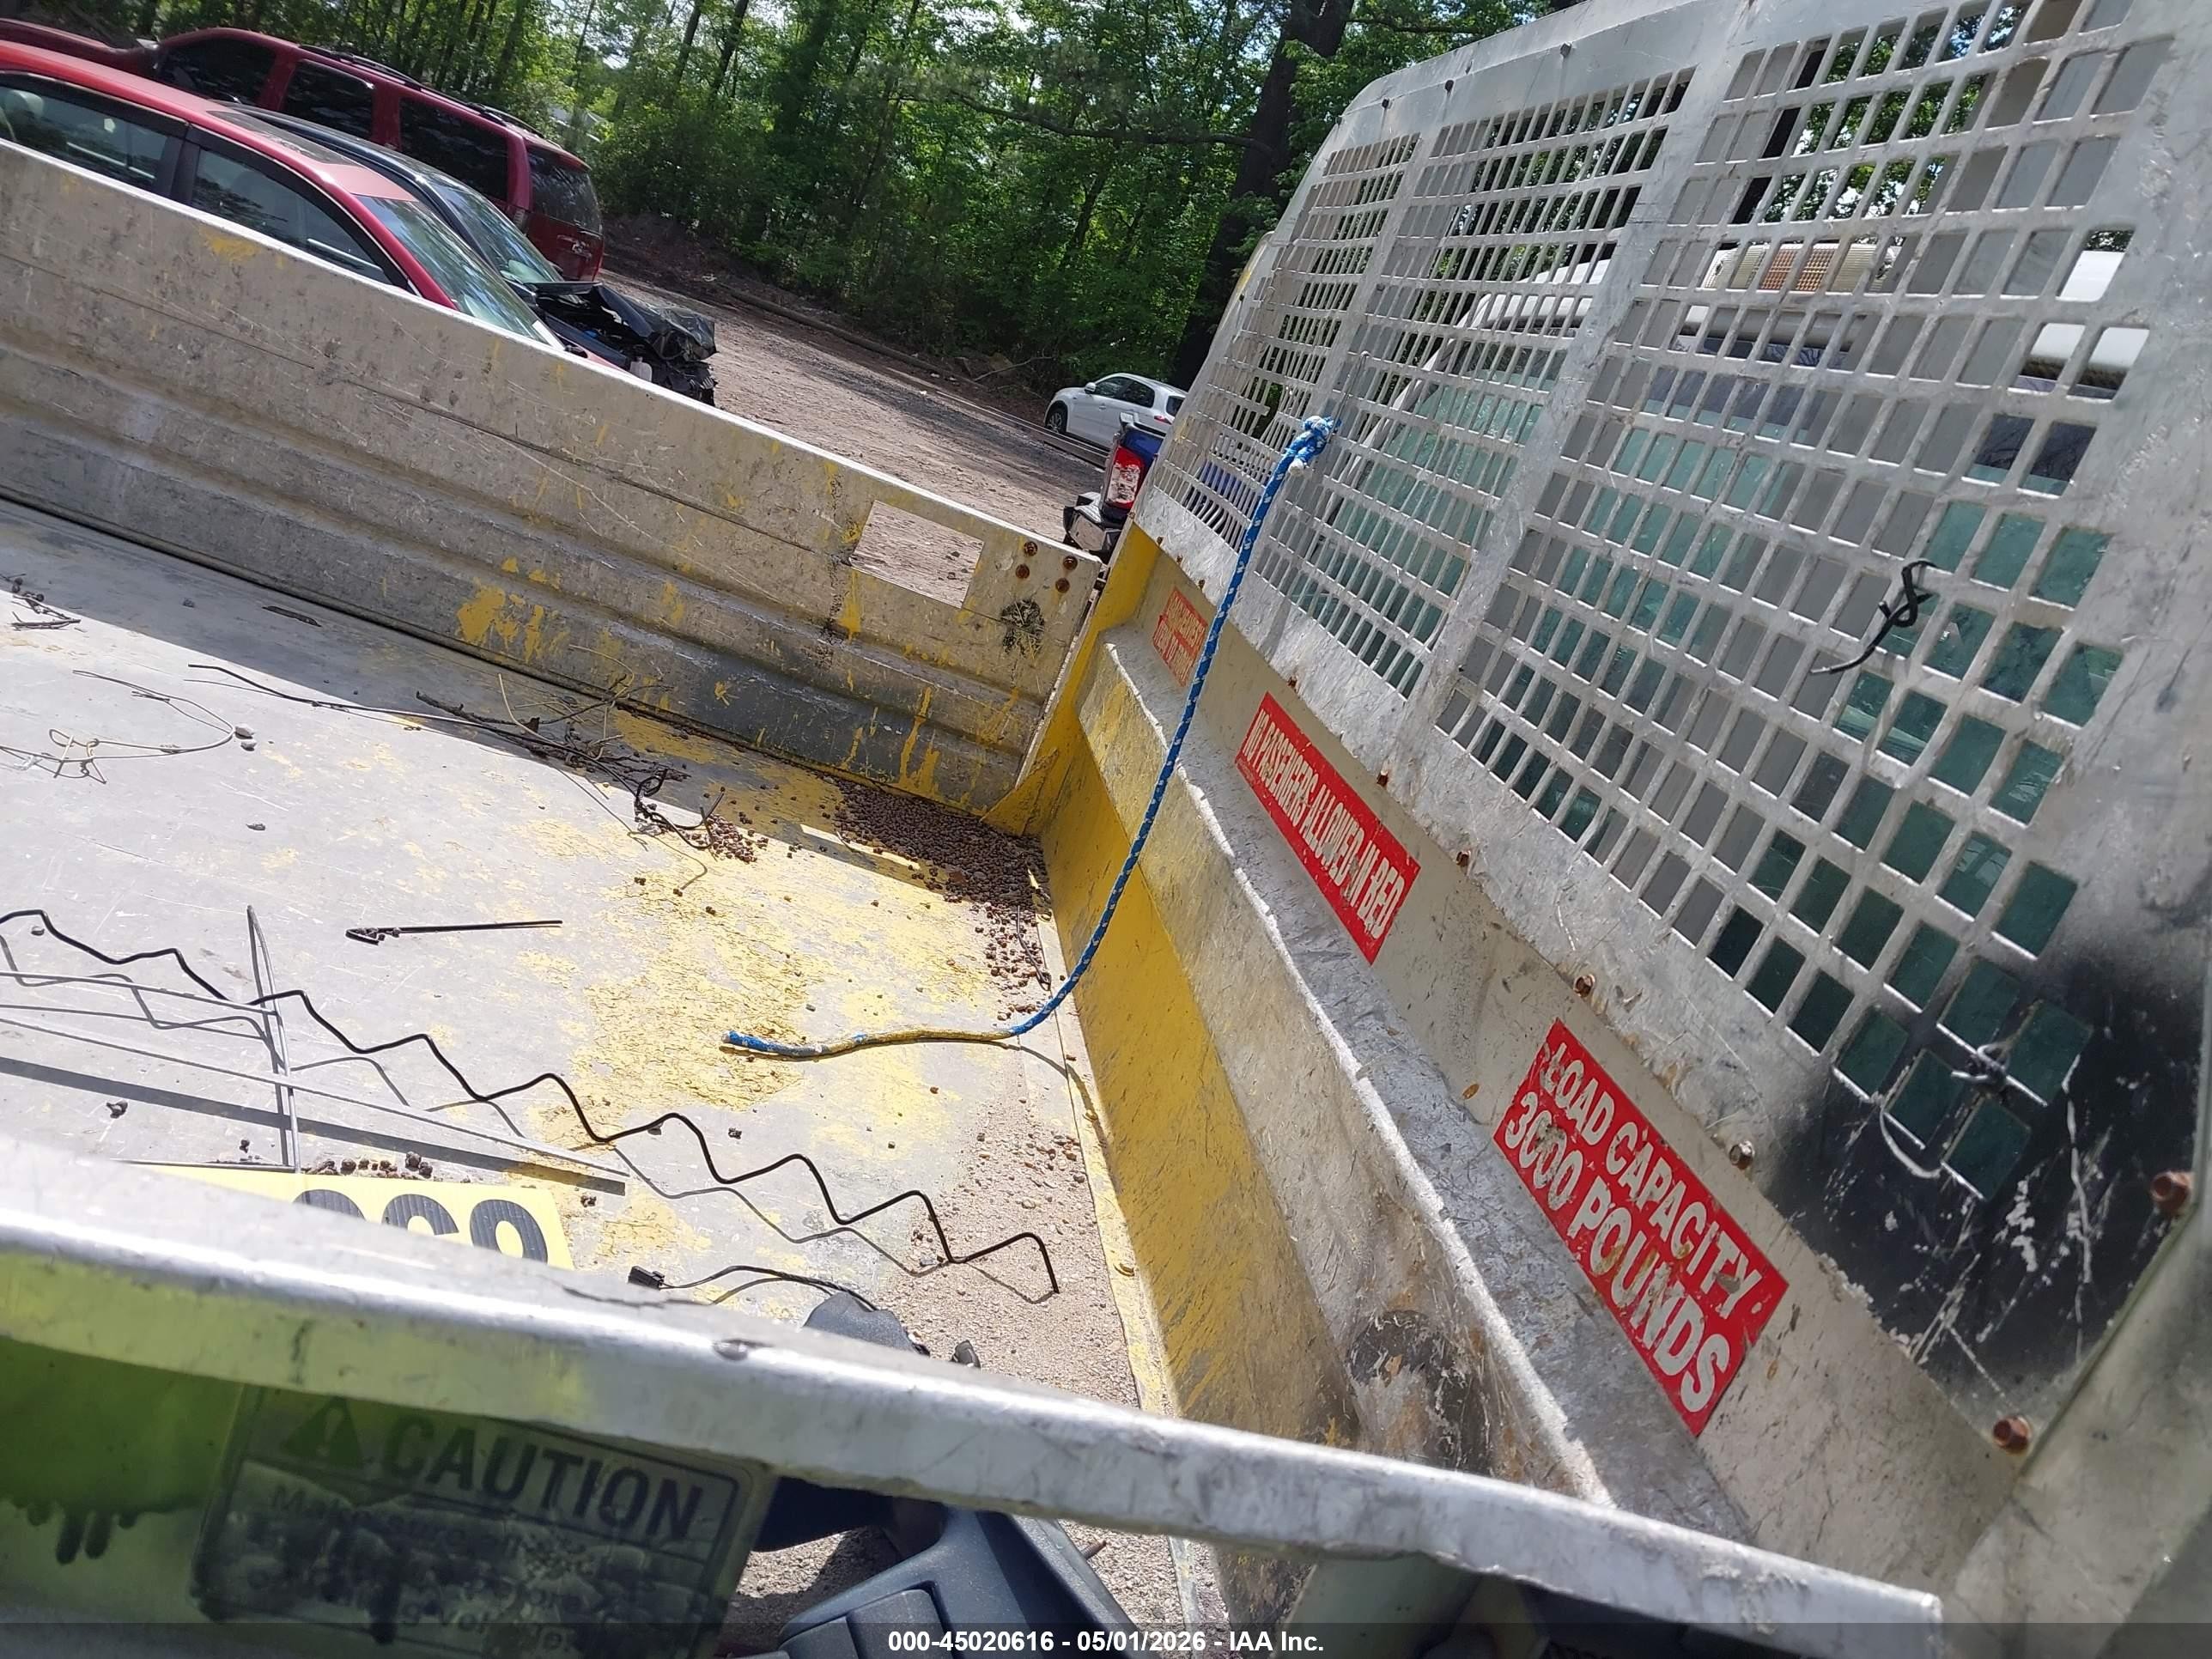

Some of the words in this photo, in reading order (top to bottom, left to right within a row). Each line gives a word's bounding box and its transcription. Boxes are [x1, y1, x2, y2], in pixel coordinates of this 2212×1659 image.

[1243, 708, 1269, 762] NO
[1253, 721, 1319, 827] PASSENGERS
[1299, 784, 1364, 886] ALLOWED
[1345, 840, 1380, 907] IN
[1357, 857, 1405, 939] BED
[1540, 1042, 1615, 1146] LOAD
[1606, 1121, 1762, 1319] CAPACITY
[1505, 1091, 1583, 1211] 3000
[1569, 1176, 1729, 1412] POUNDS
[383, 1413, 702, 1541] CAUTION
